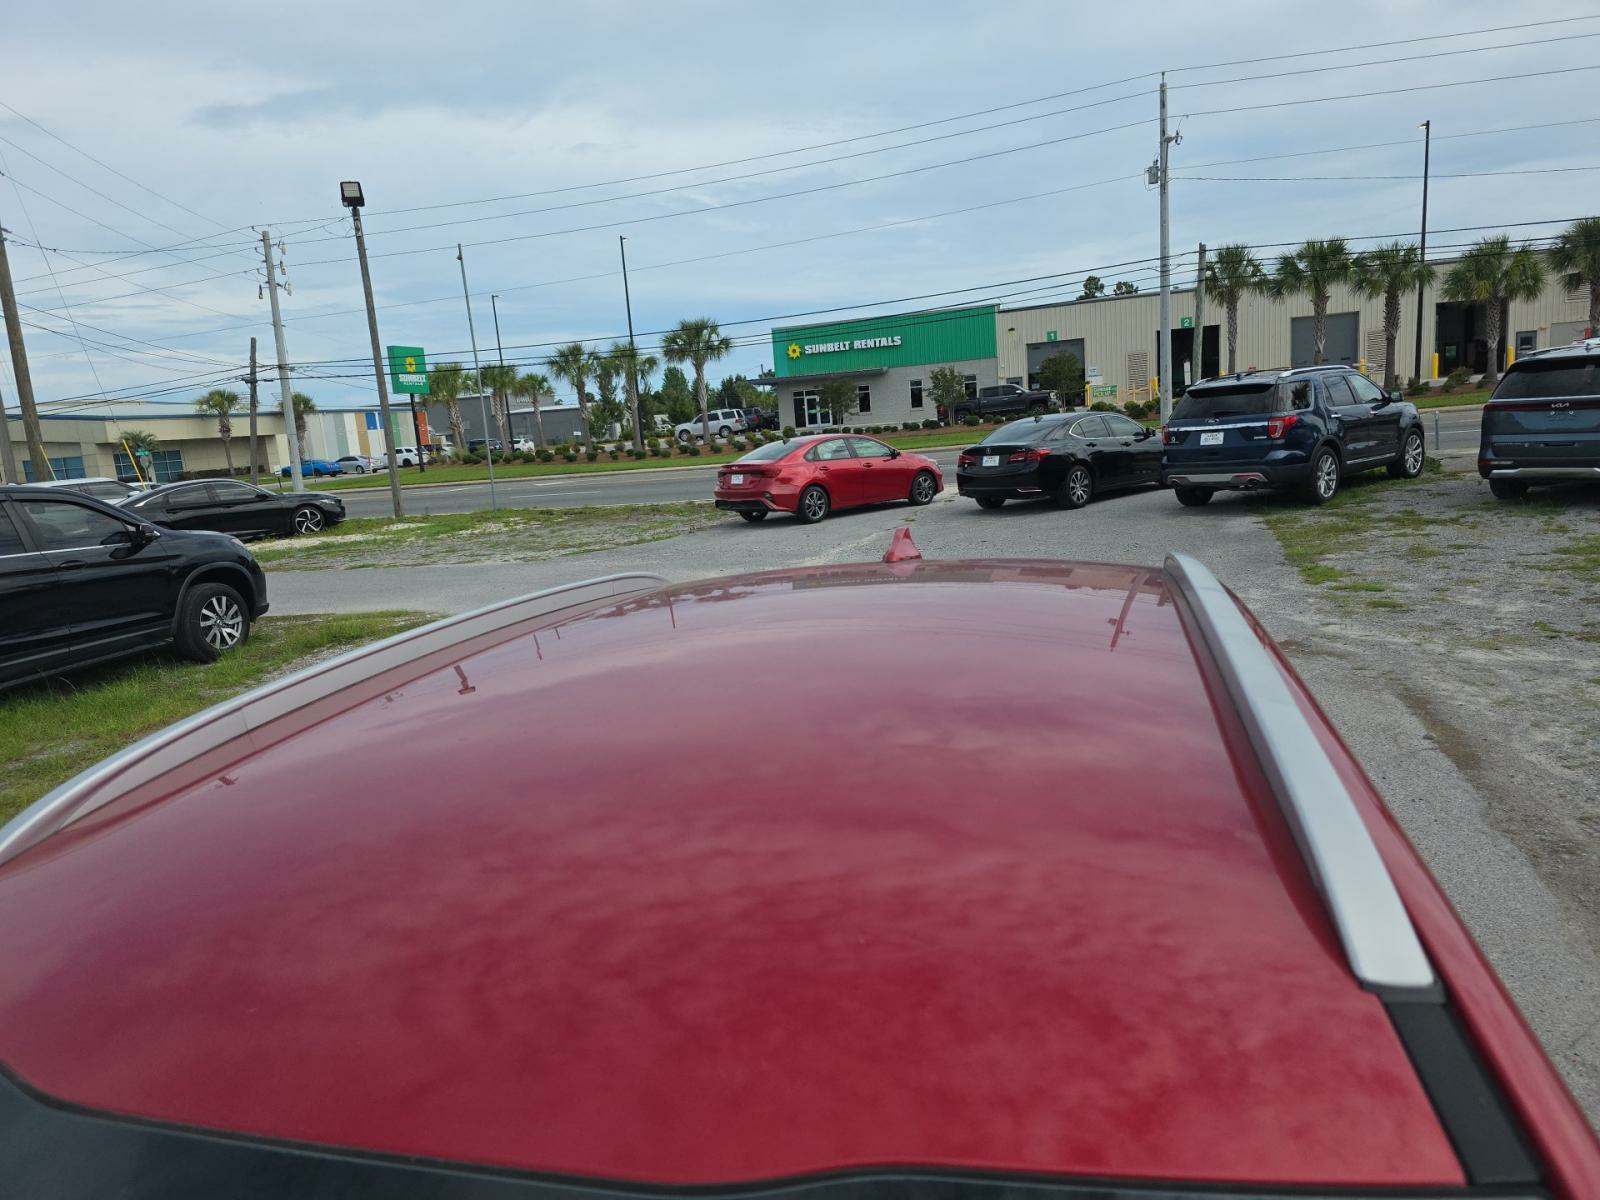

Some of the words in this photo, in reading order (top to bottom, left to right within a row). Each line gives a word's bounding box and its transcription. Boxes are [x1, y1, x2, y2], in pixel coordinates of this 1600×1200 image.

[1183, 318, 1190, 327] 2
[804, 341, 851, 355] SUNBELT
[853, 336, 902, 350] RENTALS
